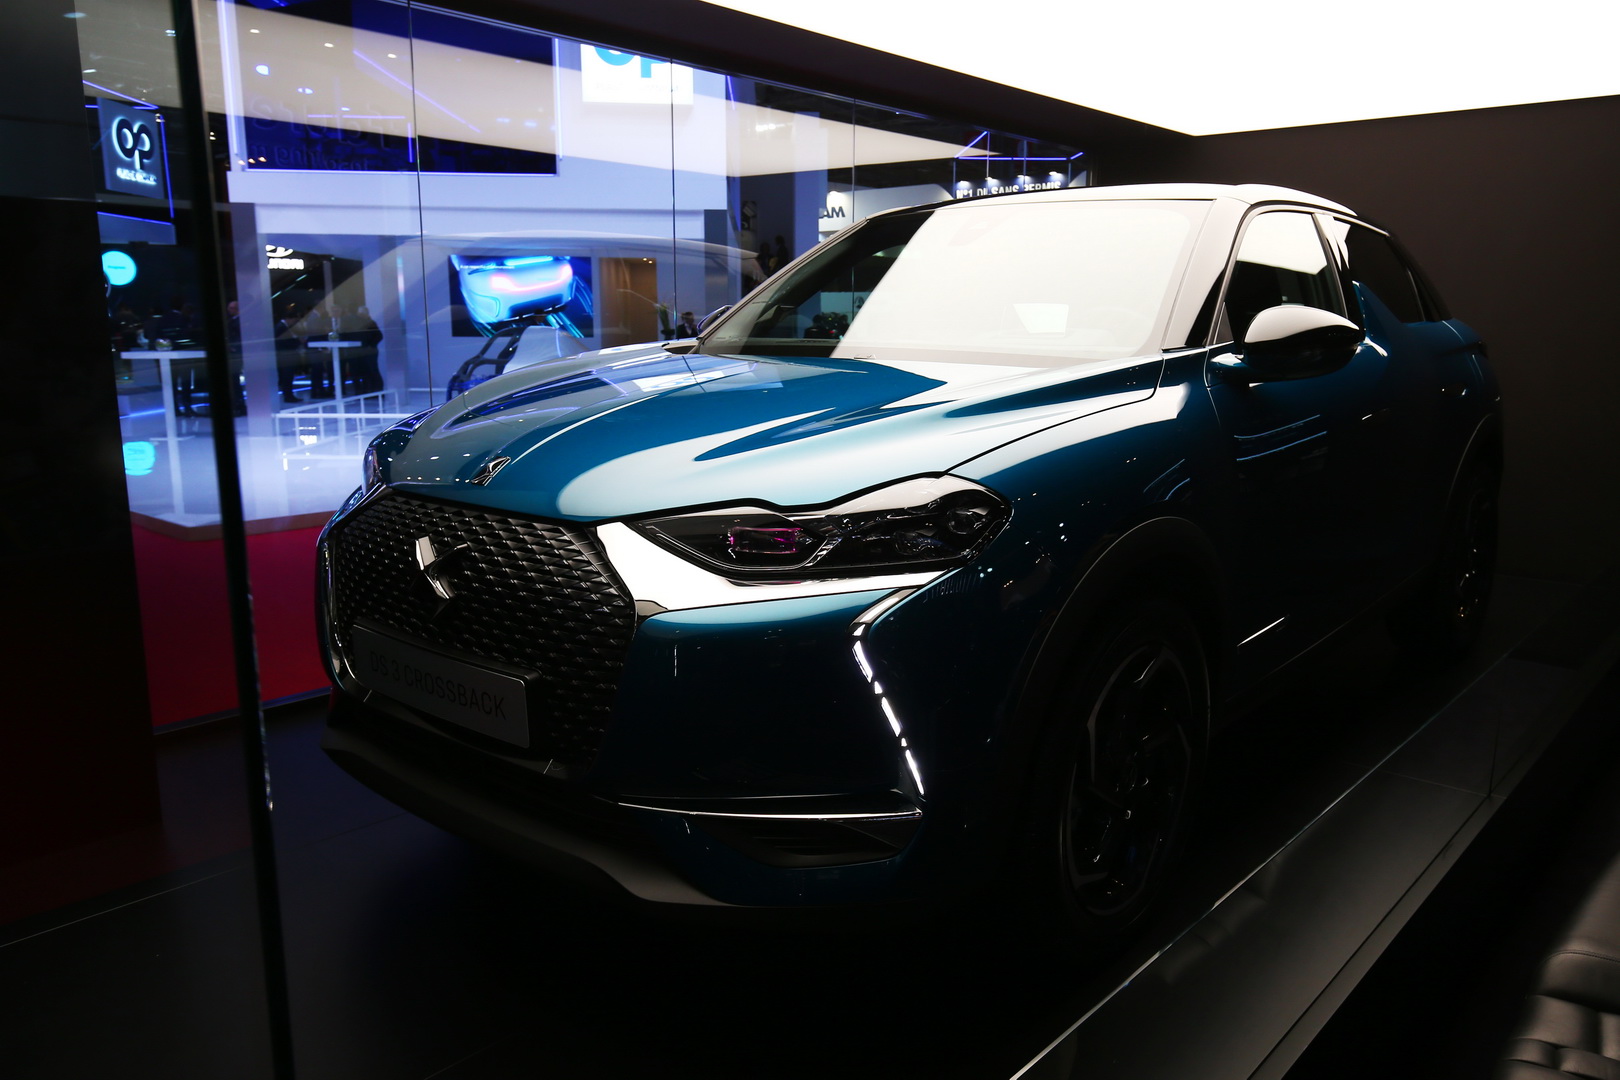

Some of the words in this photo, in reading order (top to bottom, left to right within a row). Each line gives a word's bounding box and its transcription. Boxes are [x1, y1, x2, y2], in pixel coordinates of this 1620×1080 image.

[369, 650, 389, 676] DS
[391, 659, 402, 682] 3
[403, 664, 508, 722] CROSSBACK
